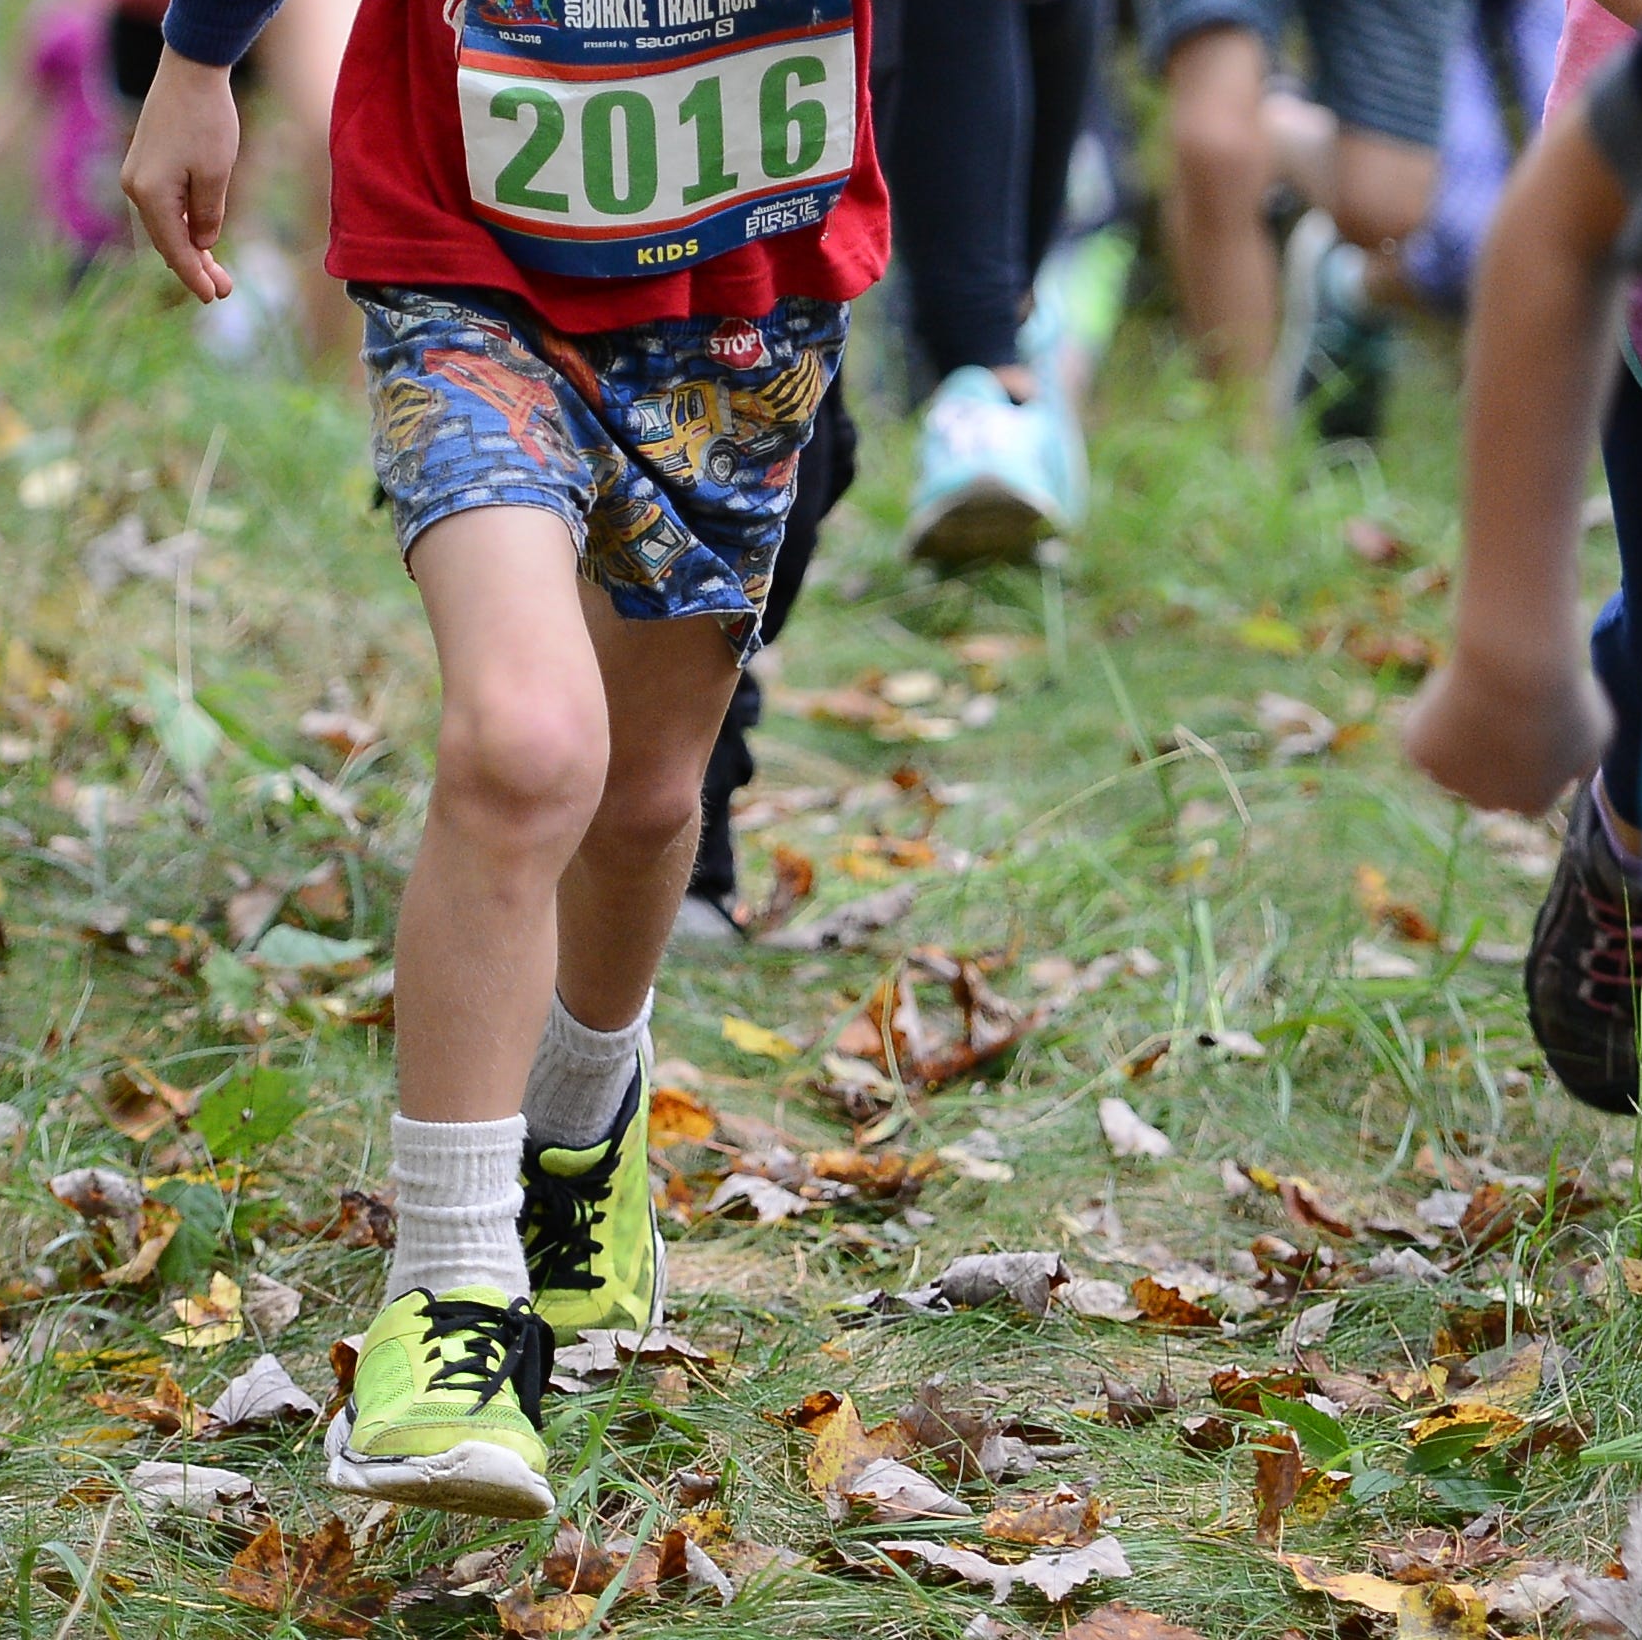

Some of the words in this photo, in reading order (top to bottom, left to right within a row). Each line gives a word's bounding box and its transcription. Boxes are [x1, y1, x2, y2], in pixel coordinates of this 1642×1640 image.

[498, 31, 542, 45] 10.1.2016
[489, 55, 828, 216] 2016
[745, 200, 820, 232] BIRKIE
[637, 237, 699, 265] KIDS
[709, 333, 757, 355] STOP
